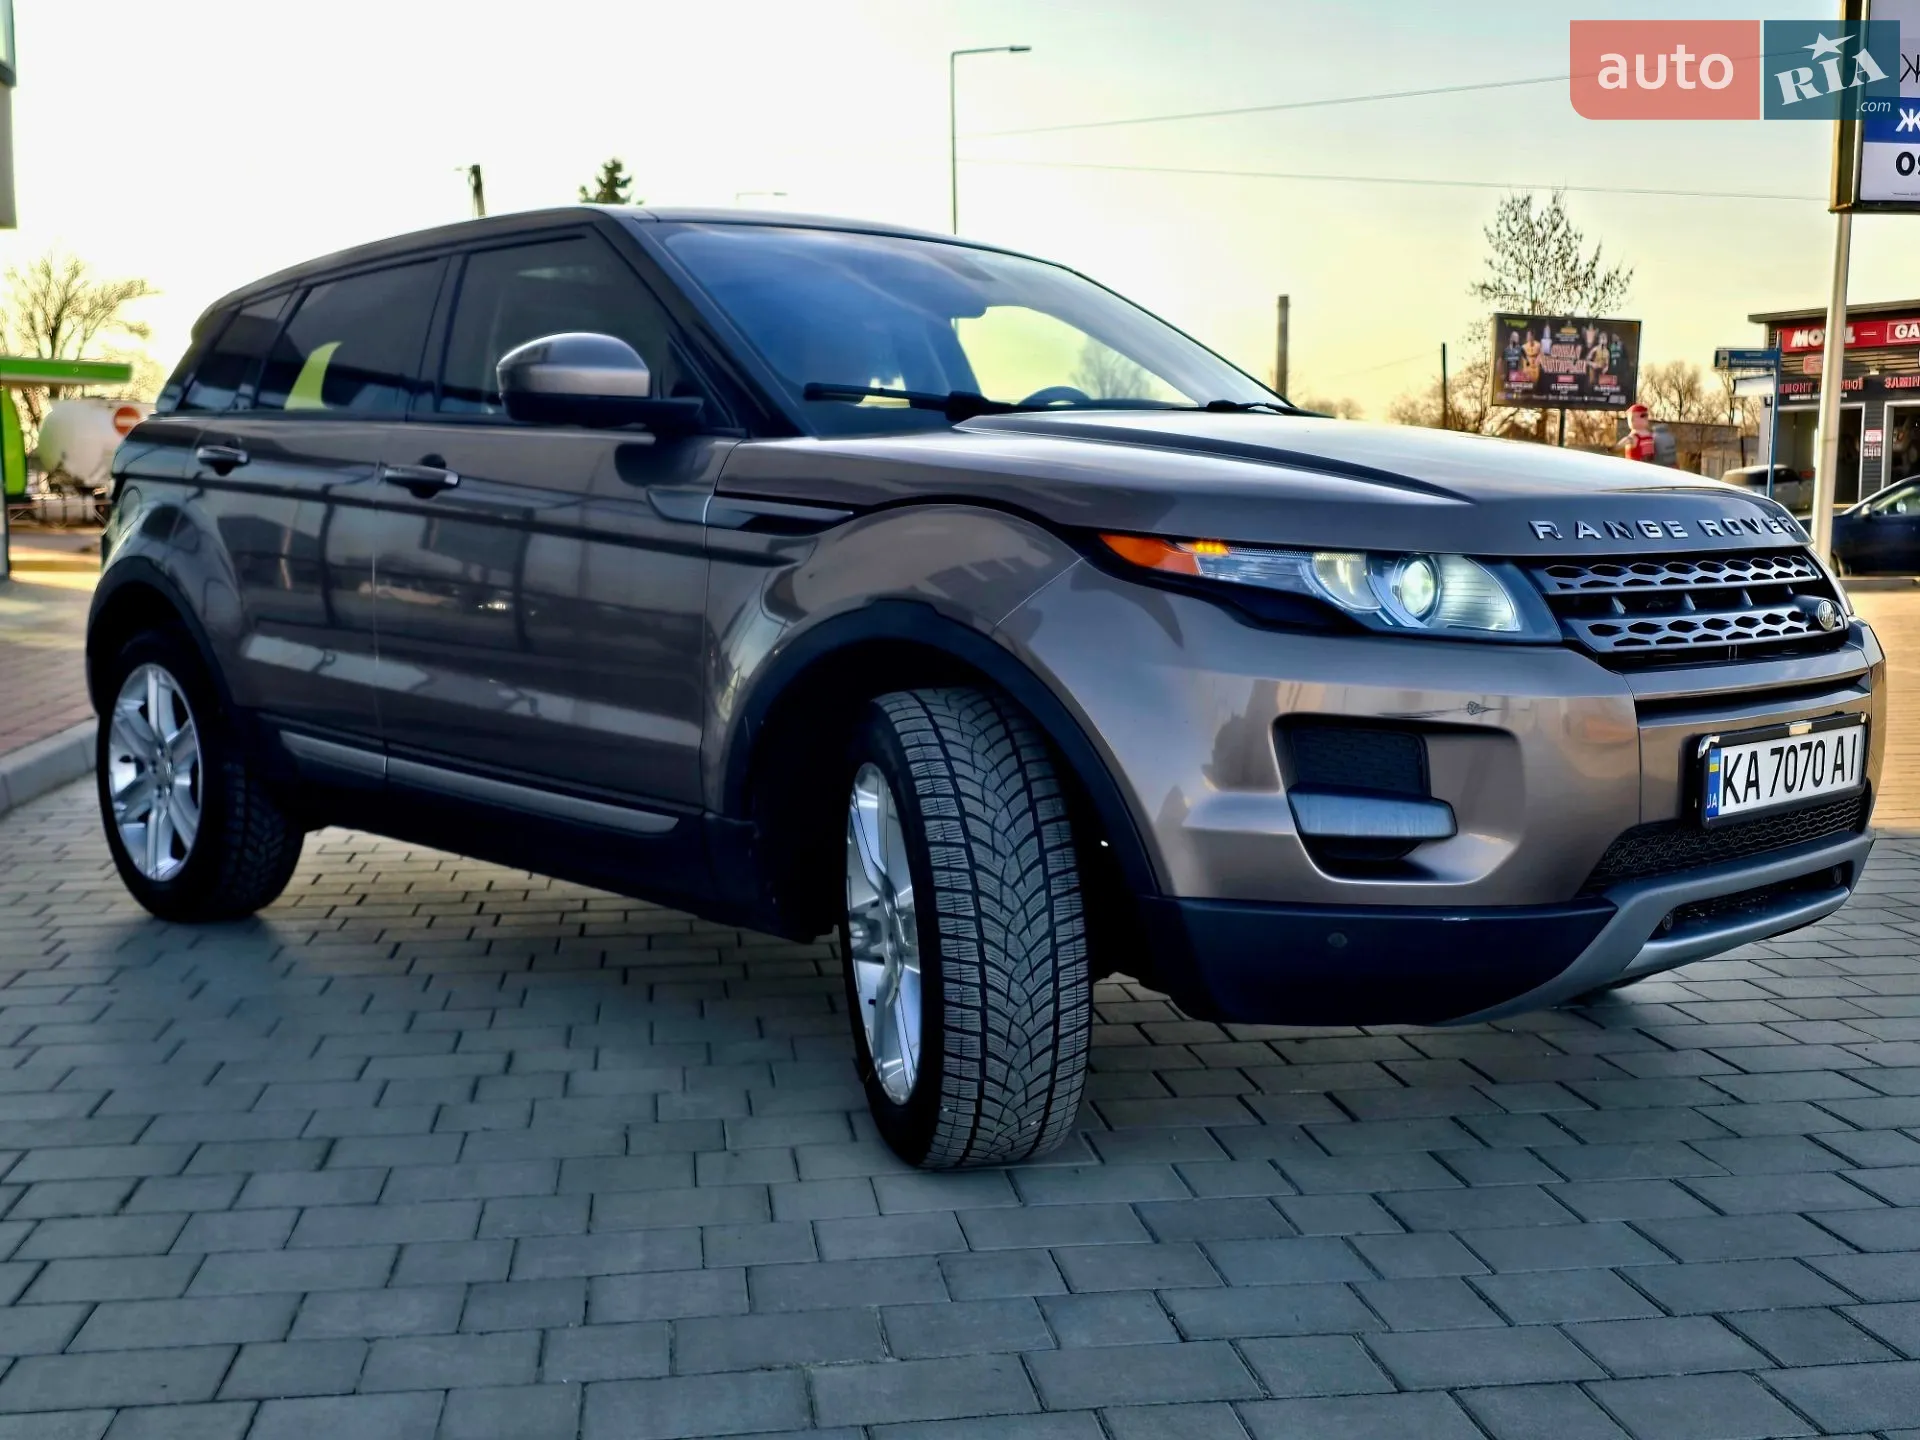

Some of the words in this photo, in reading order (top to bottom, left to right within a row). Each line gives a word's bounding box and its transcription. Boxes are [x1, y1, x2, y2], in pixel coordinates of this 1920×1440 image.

[1790, 326, 1856, 348] MOL
[1528, 519, 1689, 540] RANGE
[1697, 516, 1797, 537] ROVER
[1722, 750, 1761, 807] KA
[1769, 739, 1826, 797] 7070
[1831, 733, 1857, 785] AI
